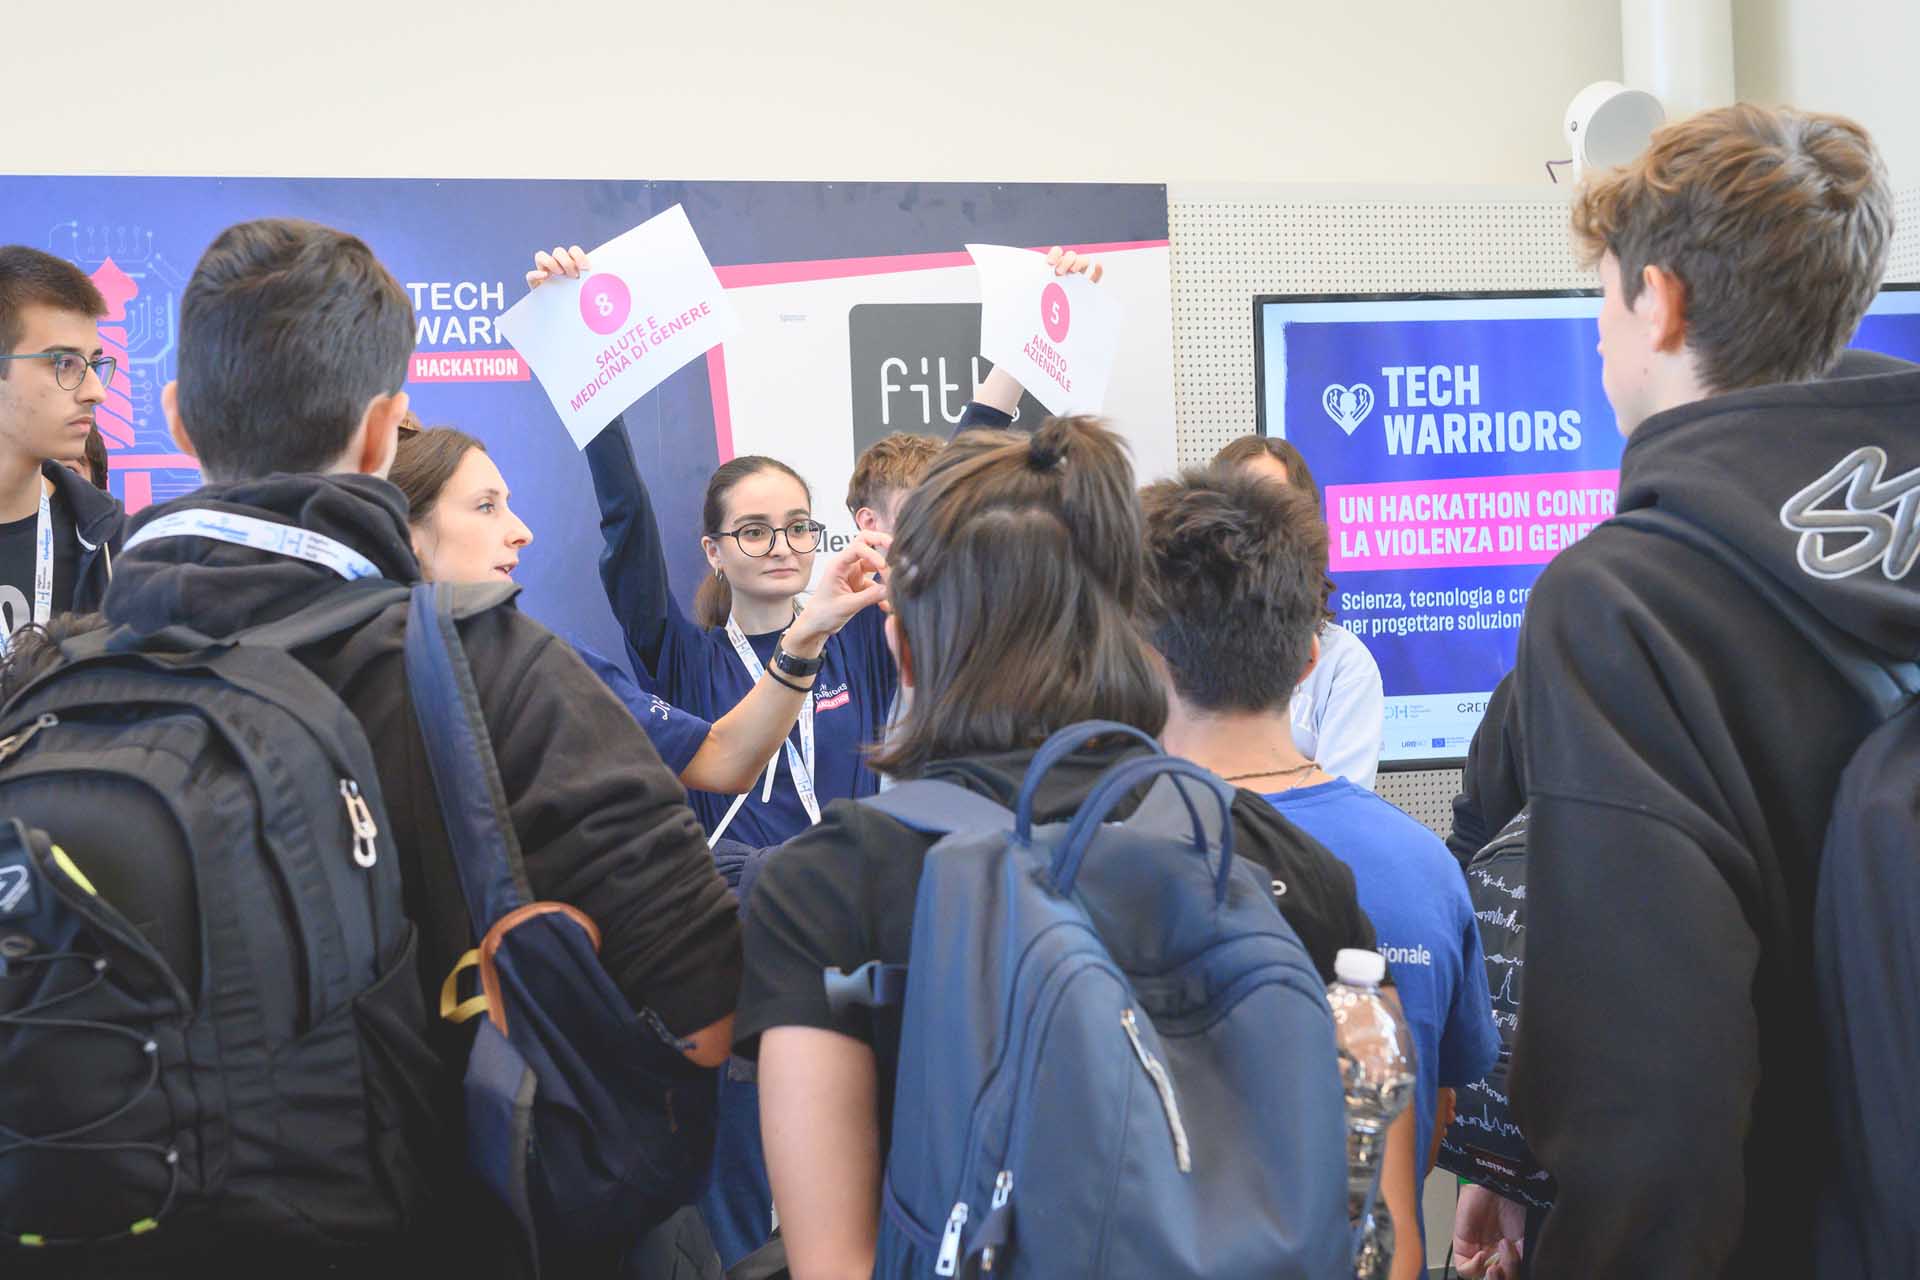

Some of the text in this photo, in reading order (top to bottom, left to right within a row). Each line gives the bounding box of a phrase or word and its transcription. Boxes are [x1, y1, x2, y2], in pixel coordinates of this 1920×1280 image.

[406, 281, 504, 311] TECH
[594, 292, 614, 317] 8
[415, 315, 502, 345] WAR
[596, 315, 659, 369] SALUTE E
[415, 357, 518, 377] HACKATHON
[570, 301, 711, 412] MEDICINA DI GENERE
[1024, 342, 1072, 392] AZIENDALE
[1033, 334, 1068, 373] AMBITO
[1381, 364, 1480, 408] TECH
[1383, 409, 1582, 455] WARRIORS
[1339, 496, 1373, 524] UN
[1380, 491, 1532, 523] HACKATHON
[1340, 530, 1371, 559] LA
[1374, 526, 1495, 558] VIOLENZA
[1499, 525, 1523, 552] DI
[1341, 591, 1406, 611] Scienza,
[1409, 586, 1493, 610] tecnologia
[1496, 590, 1505, 604] e
[1372, 614, 1455, 638] progettare
